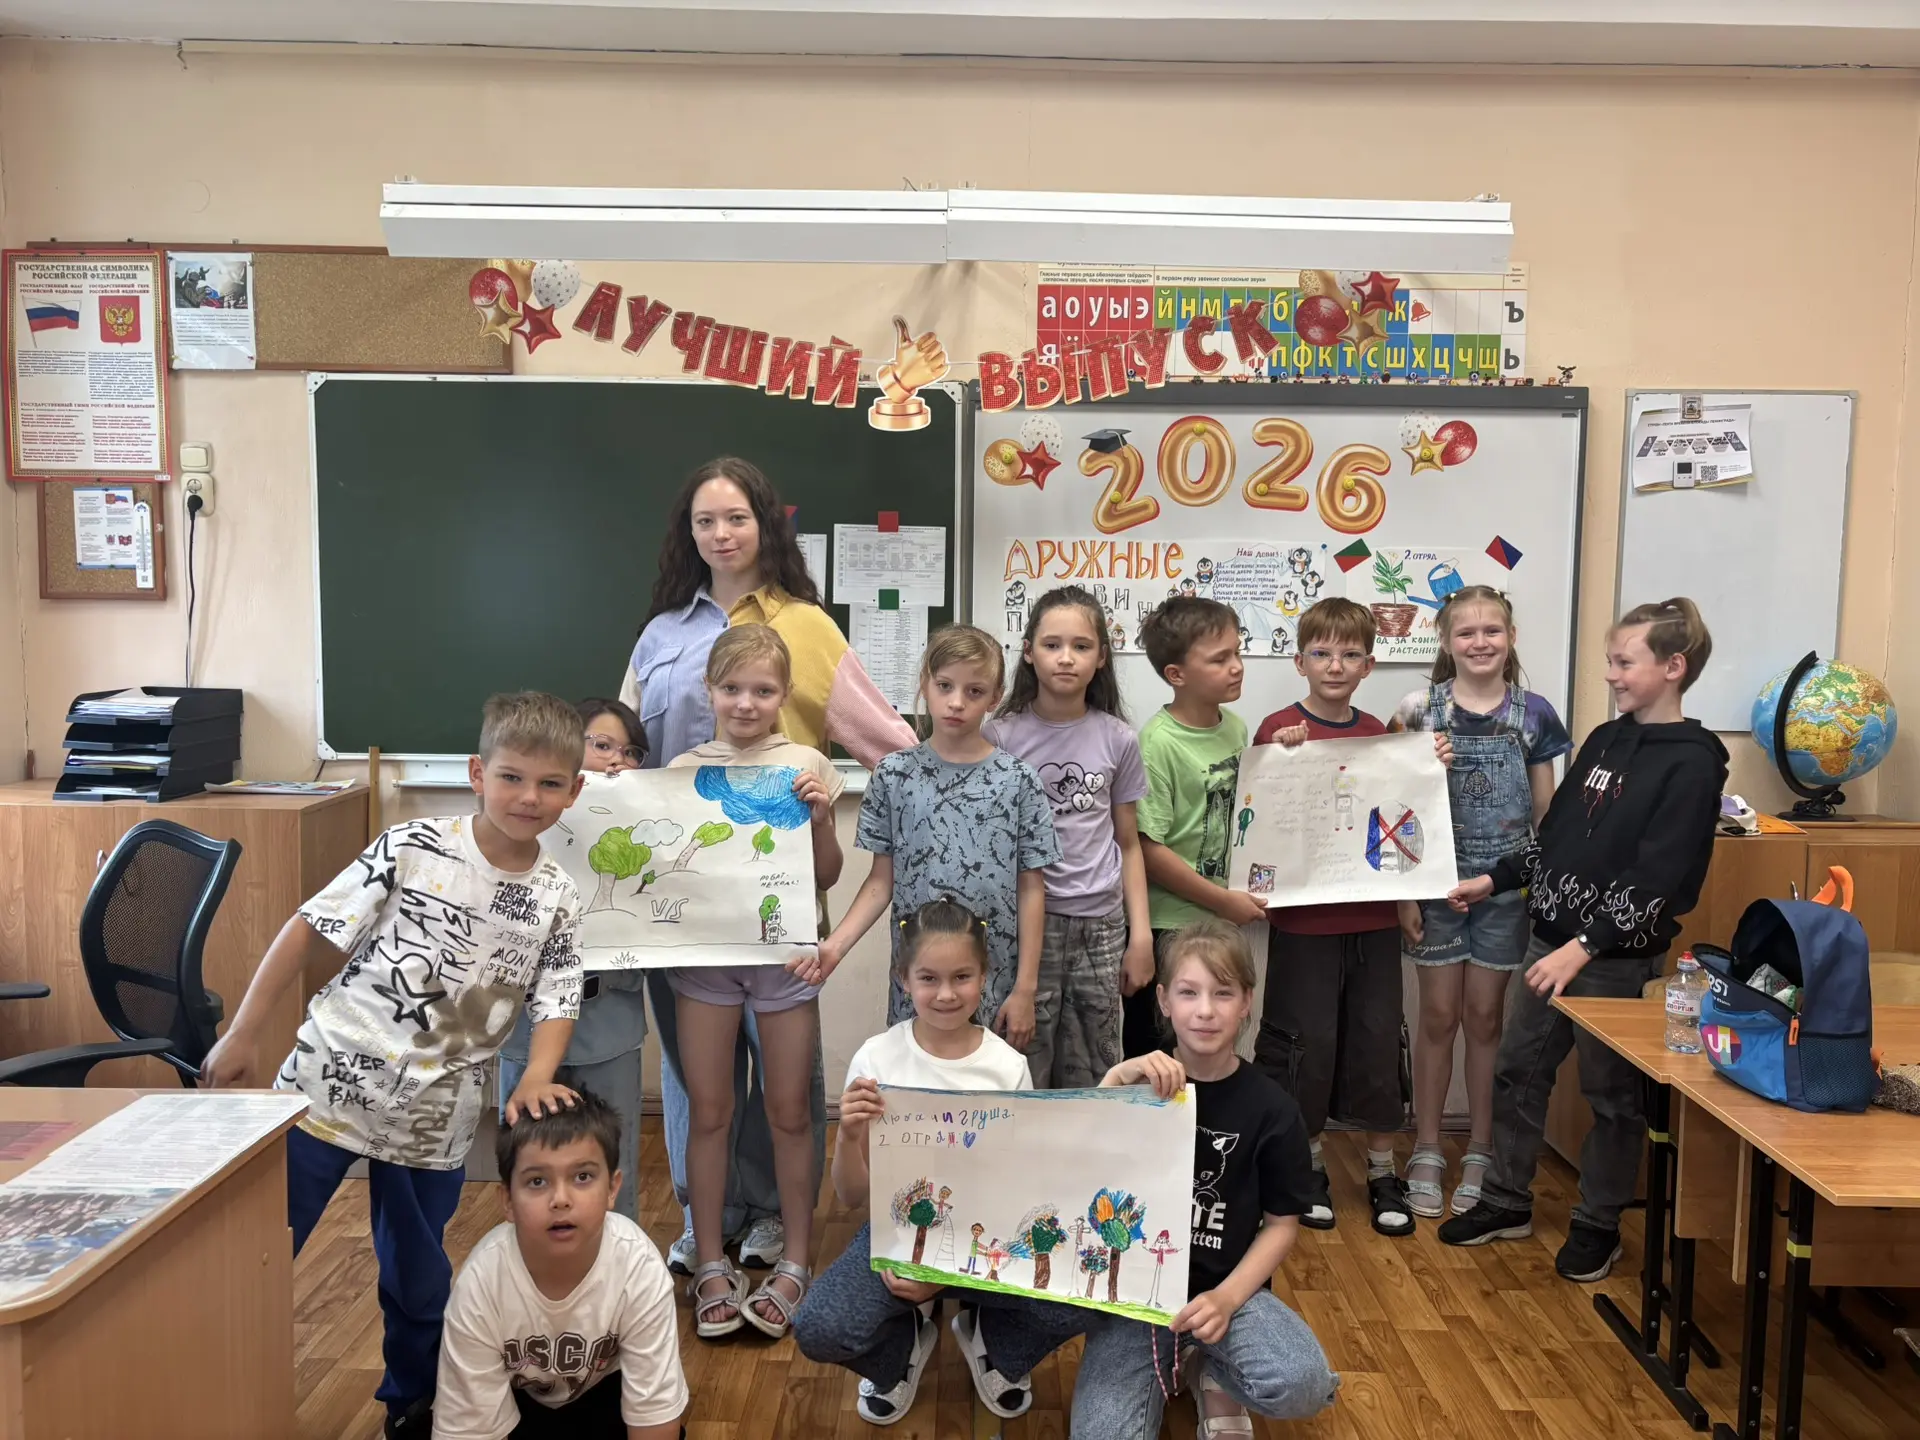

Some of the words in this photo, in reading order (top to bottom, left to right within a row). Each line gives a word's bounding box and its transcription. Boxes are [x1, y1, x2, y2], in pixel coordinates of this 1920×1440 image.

[18, 264, 98, 272] ГОСУДАРСТВЕННАЯ
[100, 264, 150, 272] СИМВОЛИКА
[32, 272, 88, 280] РОССИЙСКОЙ
[90, 272, 137, 280] ФЕДЕРАЦИИ
[572, 281, 864, 408] ЛУЧШИЙ
[978, 300, 1281, 414] ВЫПУСК
[1077, 415, 1392, 535] 2026
[1404, 549, 1411, 560] 2
[377, 887, 476, 985] STAY
[879, 1134, 889, 1147] 2
